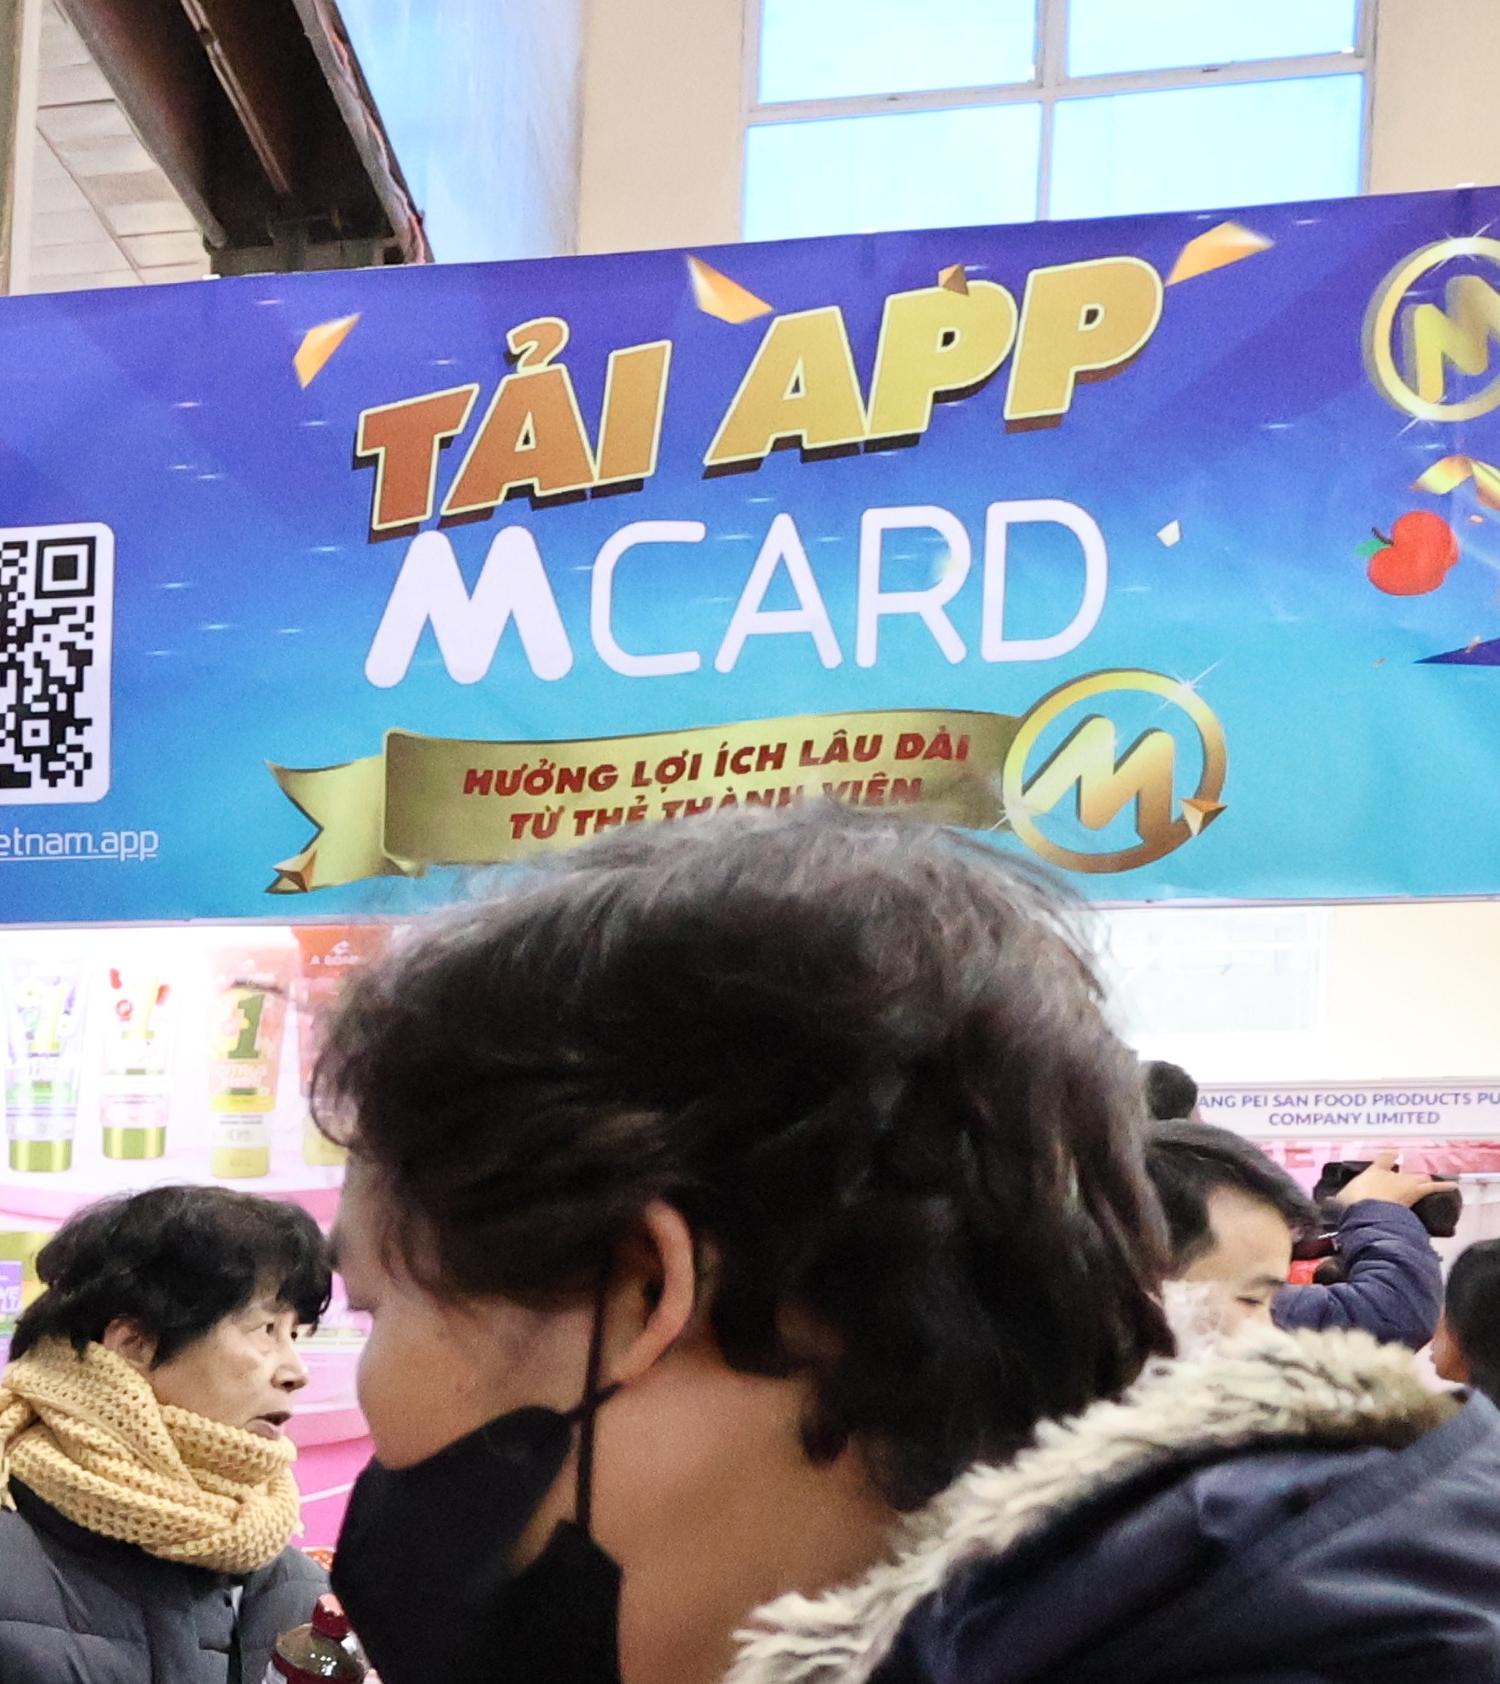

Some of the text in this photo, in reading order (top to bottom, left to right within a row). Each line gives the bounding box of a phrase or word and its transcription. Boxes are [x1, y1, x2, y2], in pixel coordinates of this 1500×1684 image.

[352, 256, 1166, 540] TẢI APP
[463, 757, 619, 797] HƯỞNG
[630, 748, 702, 797] LỢI
[713, 741, 788, 778] ÍCH
[798, 729, 885, 769] LÂU
[509, 803, 564, 841] TỪ
[1241, 1092, 1473, 1108] PEI SAN FOOD PRODUCTS
[1268, 1111, 1441, 1127] COMPANY LIMITED
